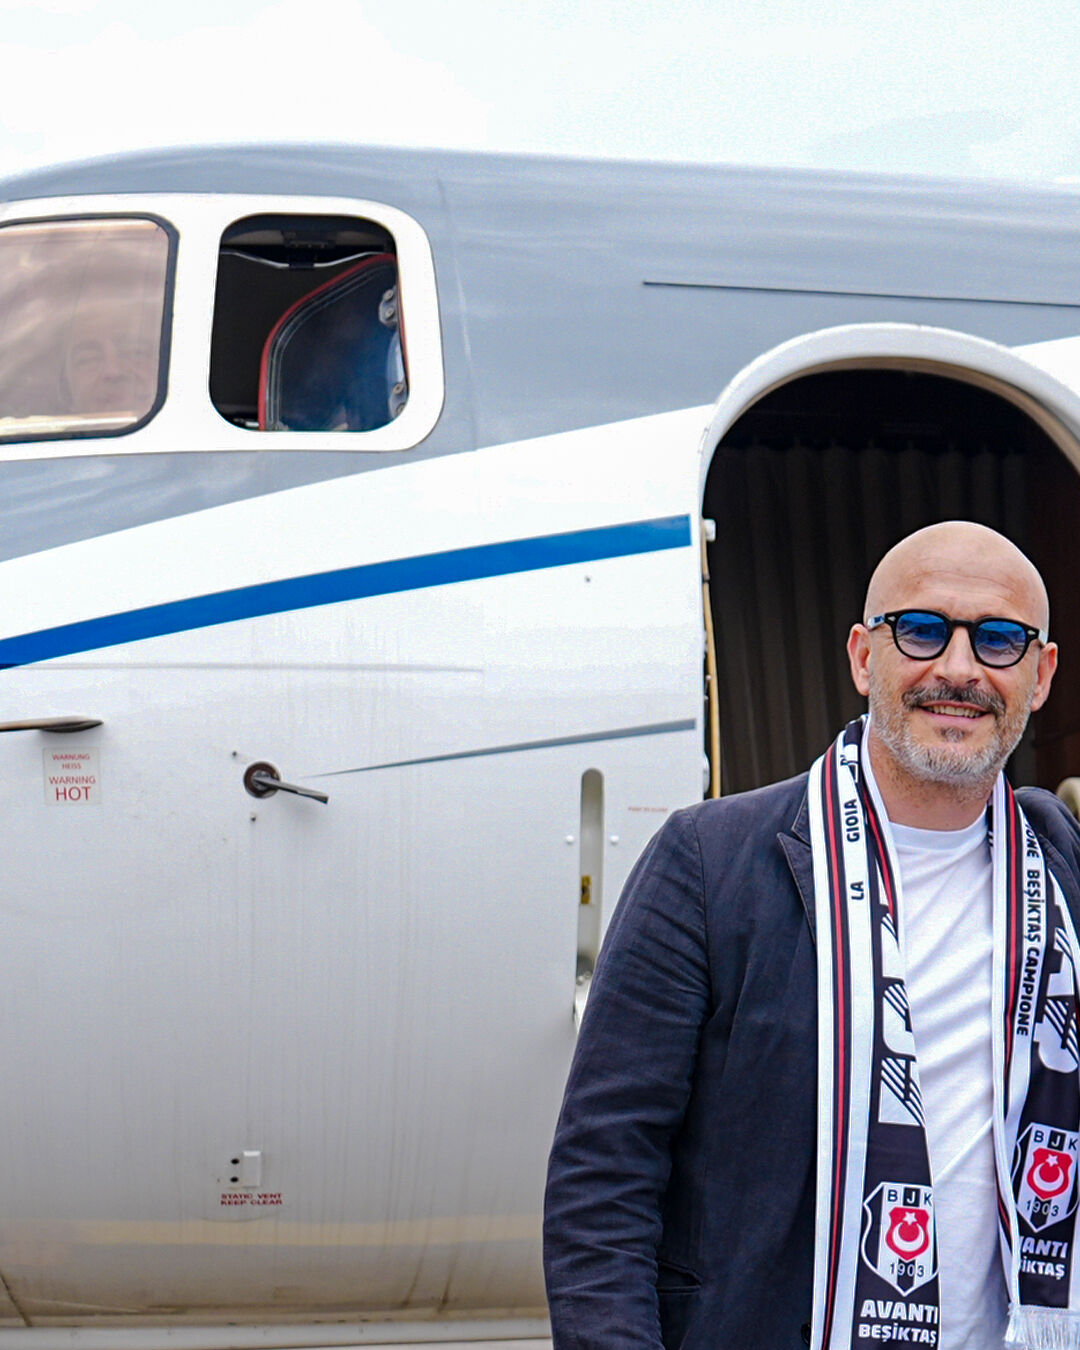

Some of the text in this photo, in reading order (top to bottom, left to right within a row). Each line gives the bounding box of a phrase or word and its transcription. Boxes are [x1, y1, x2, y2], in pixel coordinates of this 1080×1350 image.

[48, 775, 96, 785] WARNING
[55, 786, 91, 801] HOT
[844, 799, 861, 843] GIOIA
[851, 881, 865, 901] LA
[1023, 869, 1046, 944] BEŞİKTAŞ
[1016, 947, 1041, 1037] CAMPIONE
[1026, 1199, 1059, 1217] 1903
[890, 1262, 925, 1278] 1903
[860, 1299, 938, 1323] AVANTI
[858, 1323, 937, 1347] BEŞİKTAŞ
